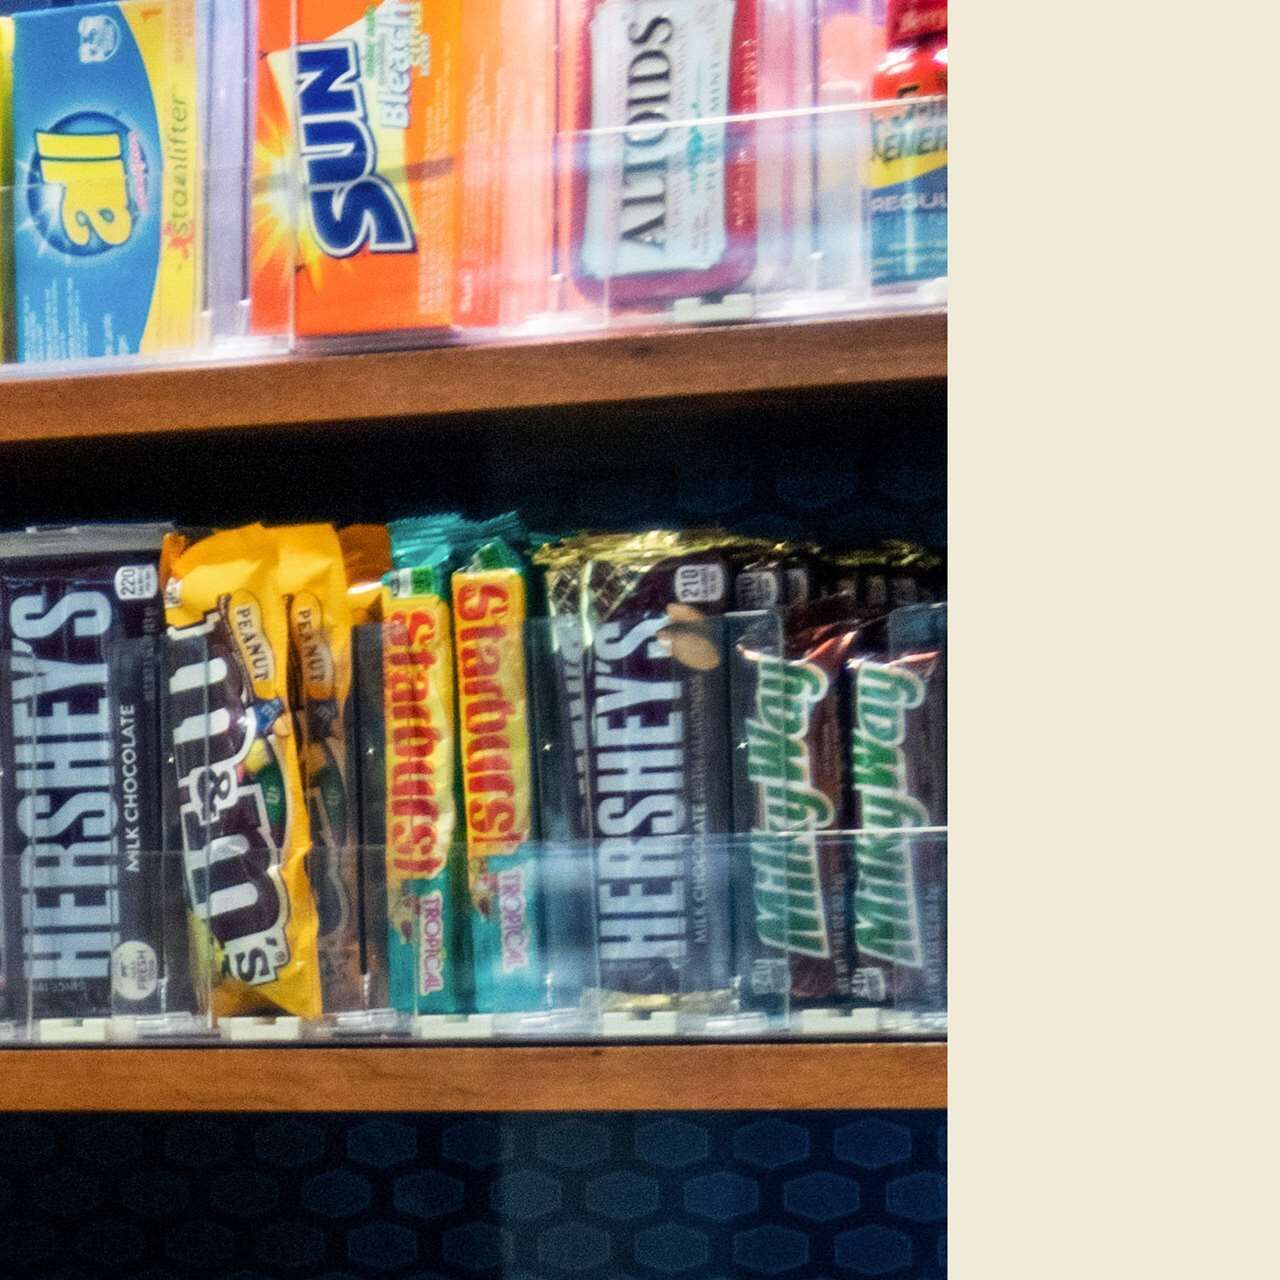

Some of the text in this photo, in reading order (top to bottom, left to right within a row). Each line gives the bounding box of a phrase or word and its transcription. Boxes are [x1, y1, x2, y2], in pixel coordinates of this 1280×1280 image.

[376, 1, 411, 128] Bleach
[33, 131, 134, 247] all
[296, 40, 418, 258] SUN
[620, 14, 673, 252] ALTOIDS
[119, 568, 138, 596] 220
[235, 604, 272, 682] PEANUT
[679, 569, 700, 598] 210
[388, 609, 443, 874] Starburst
[454, 584, 525, 843] Starburst
[10, 591, 120, 979] HERSHEY'S
[120, 706, 141, 873] MILK CHOCOLATE
[594, 619, 688, 960] HERSHEY'S
[691, 804, 708, 901] CHOCOLATE
[420, 892, 443, 995] TROPICAL
[693, 904, 708, 943] MILK
